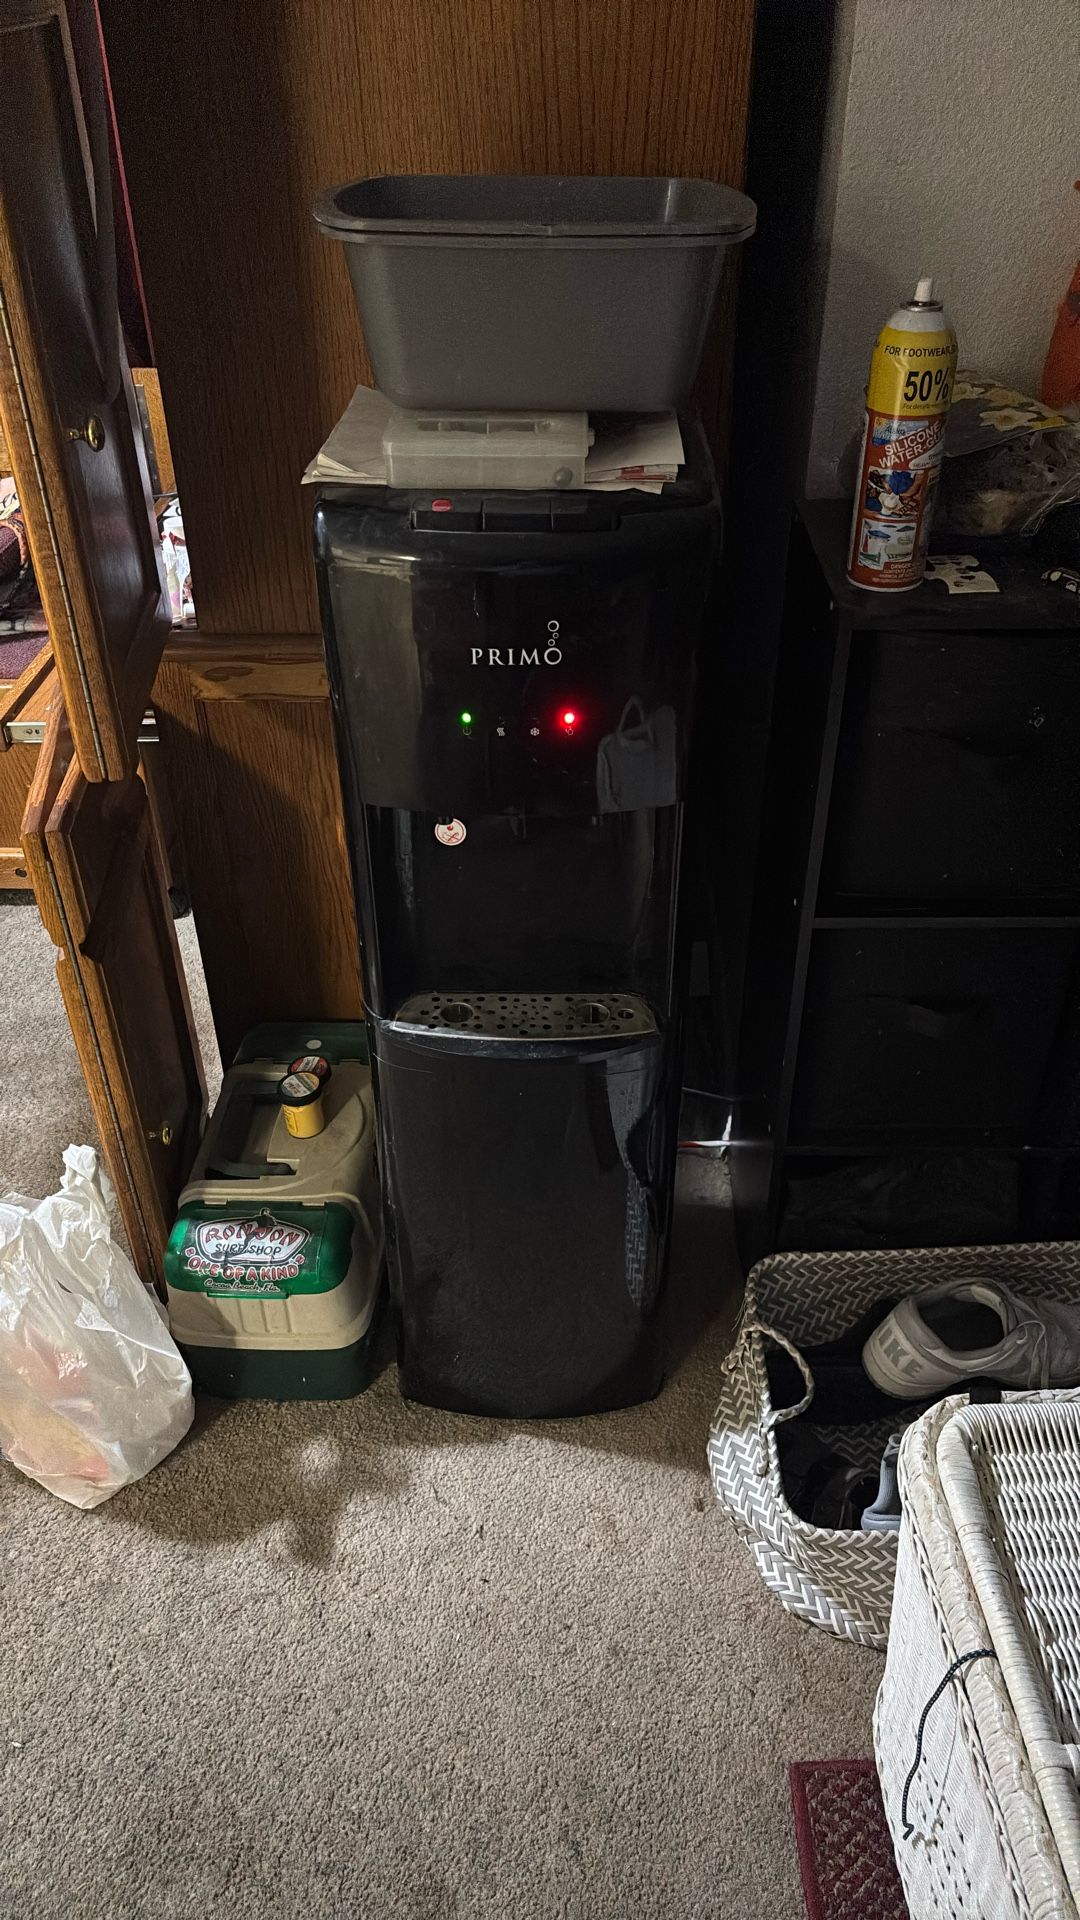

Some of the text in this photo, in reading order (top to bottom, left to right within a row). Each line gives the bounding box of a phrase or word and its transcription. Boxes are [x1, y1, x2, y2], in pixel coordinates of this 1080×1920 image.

[884, 345, 901, 356] FOR
[904, 368, 949, 402] 50%
[884, 420, 942, 456] SILICONE
[470, 647, 563, 666] PRIMO
[205, 1222, 301, 1247] RON JON
[215, 1243, 282, 1256] SURF SHOP
[222, 1264, 244, 1281] OF
[246, 1266, 259, 1282] A
